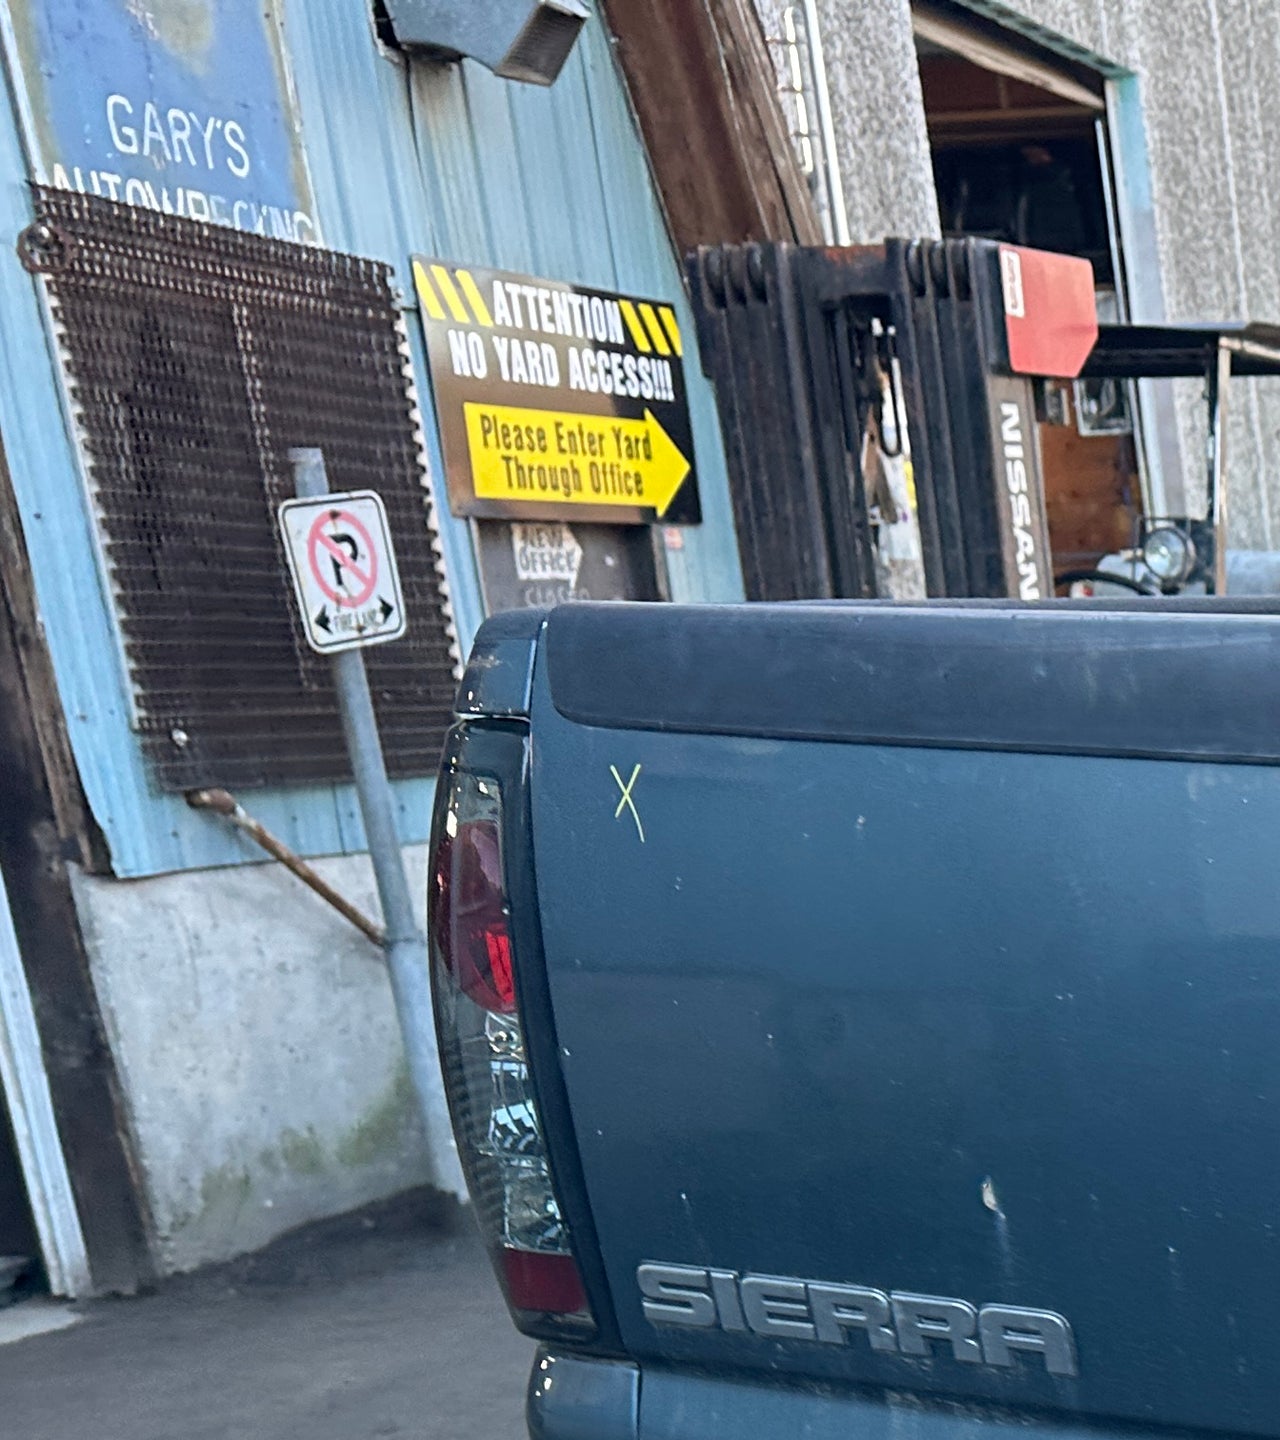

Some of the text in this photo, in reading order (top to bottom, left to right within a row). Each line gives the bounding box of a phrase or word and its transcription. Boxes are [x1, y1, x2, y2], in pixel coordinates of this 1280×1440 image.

[106, 94, 250, 178] GARY'S
[492, 280, 625, 345] ATTENTION
[447, 329, 675, 402] NO YARD ACCESS!!!
[480, 414, 652, 461] Please Enter Yard
[501, 455, 645, 498] Through Office
[1000, 402, 1040, 600] NISSAN
[637, 1259, 1079, 1377] SIERRA
